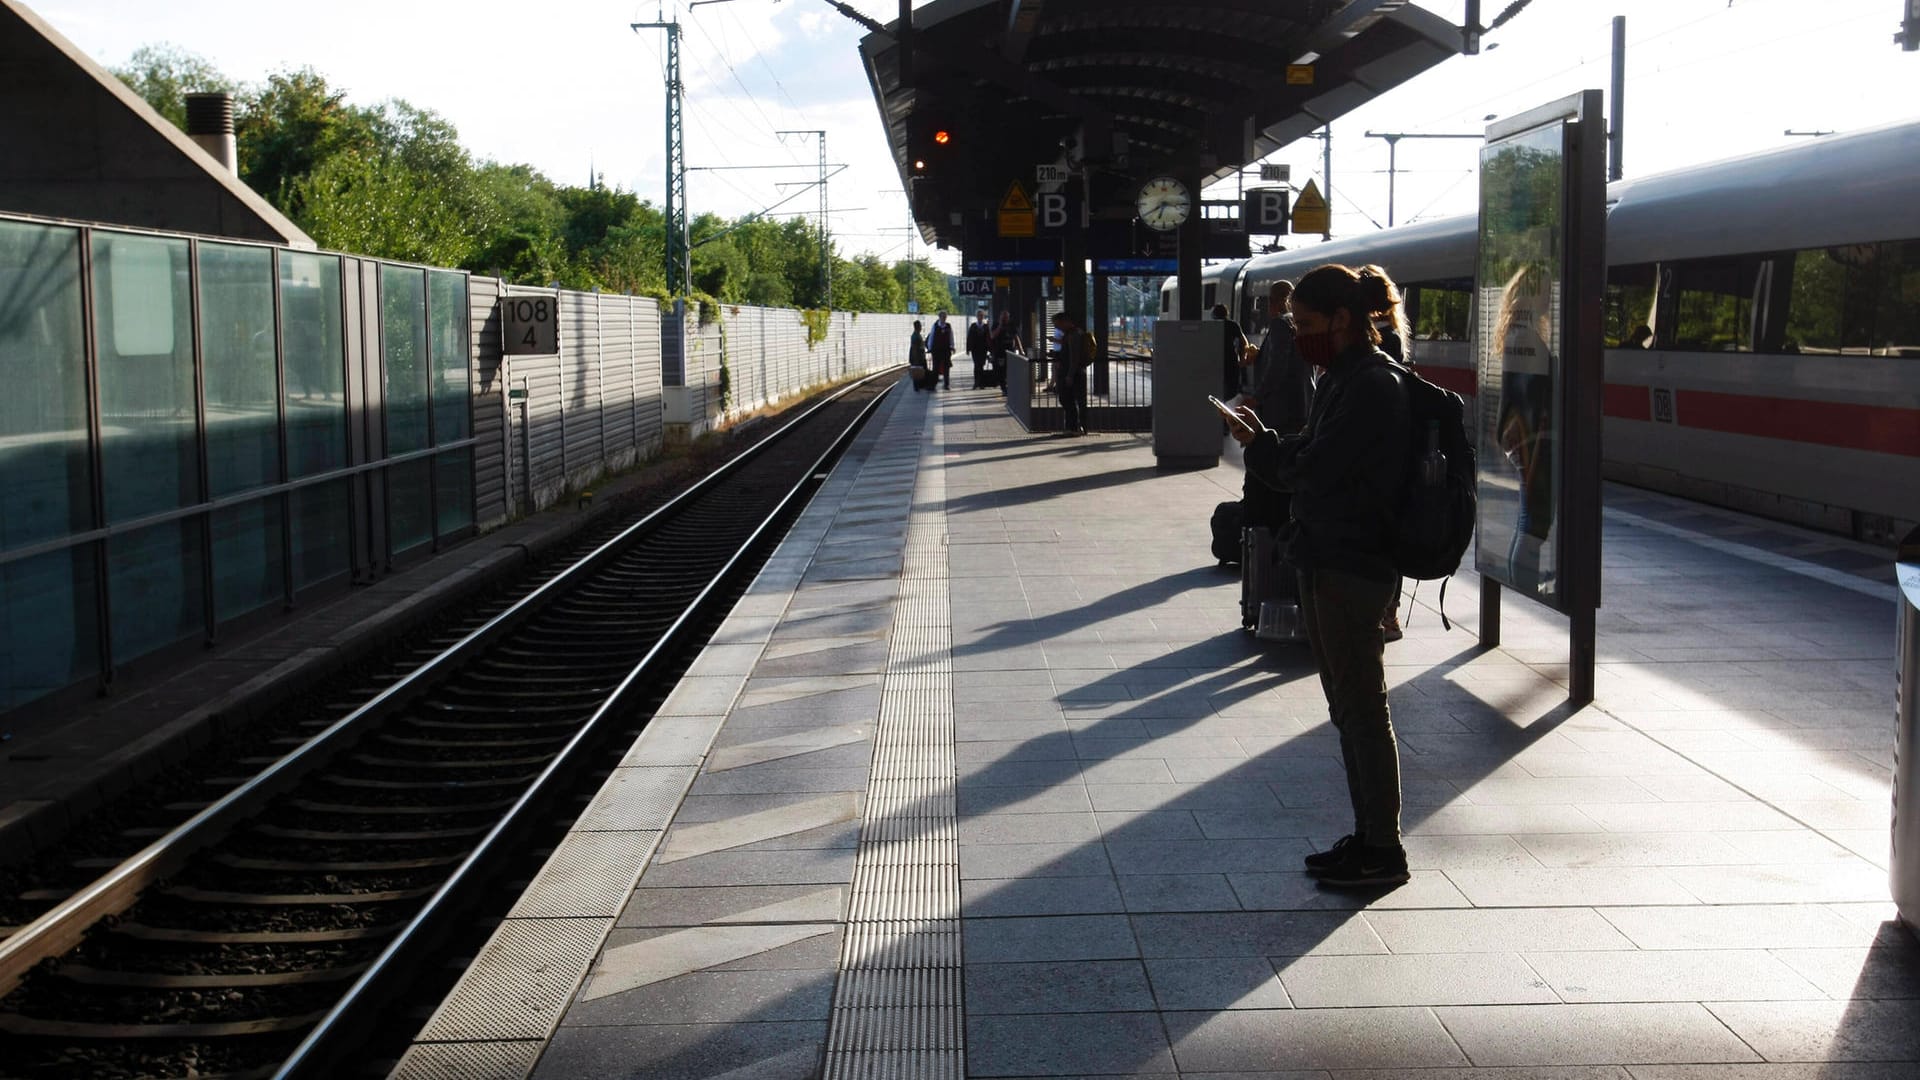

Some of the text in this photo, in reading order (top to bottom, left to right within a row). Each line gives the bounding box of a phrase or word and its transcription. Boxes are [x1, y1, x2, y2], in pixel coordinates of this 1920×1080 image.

[1043, 194, 1068, 228] B
[1260, 193, 1284, 225] B
[960, 281, 990, 293] 10 A
[1662, 268, 1672, 299] 2
[508, 299, 549, 323] 108
[521, 326, 537, 348] 4
[1655, 394, 1672, 418] DB
